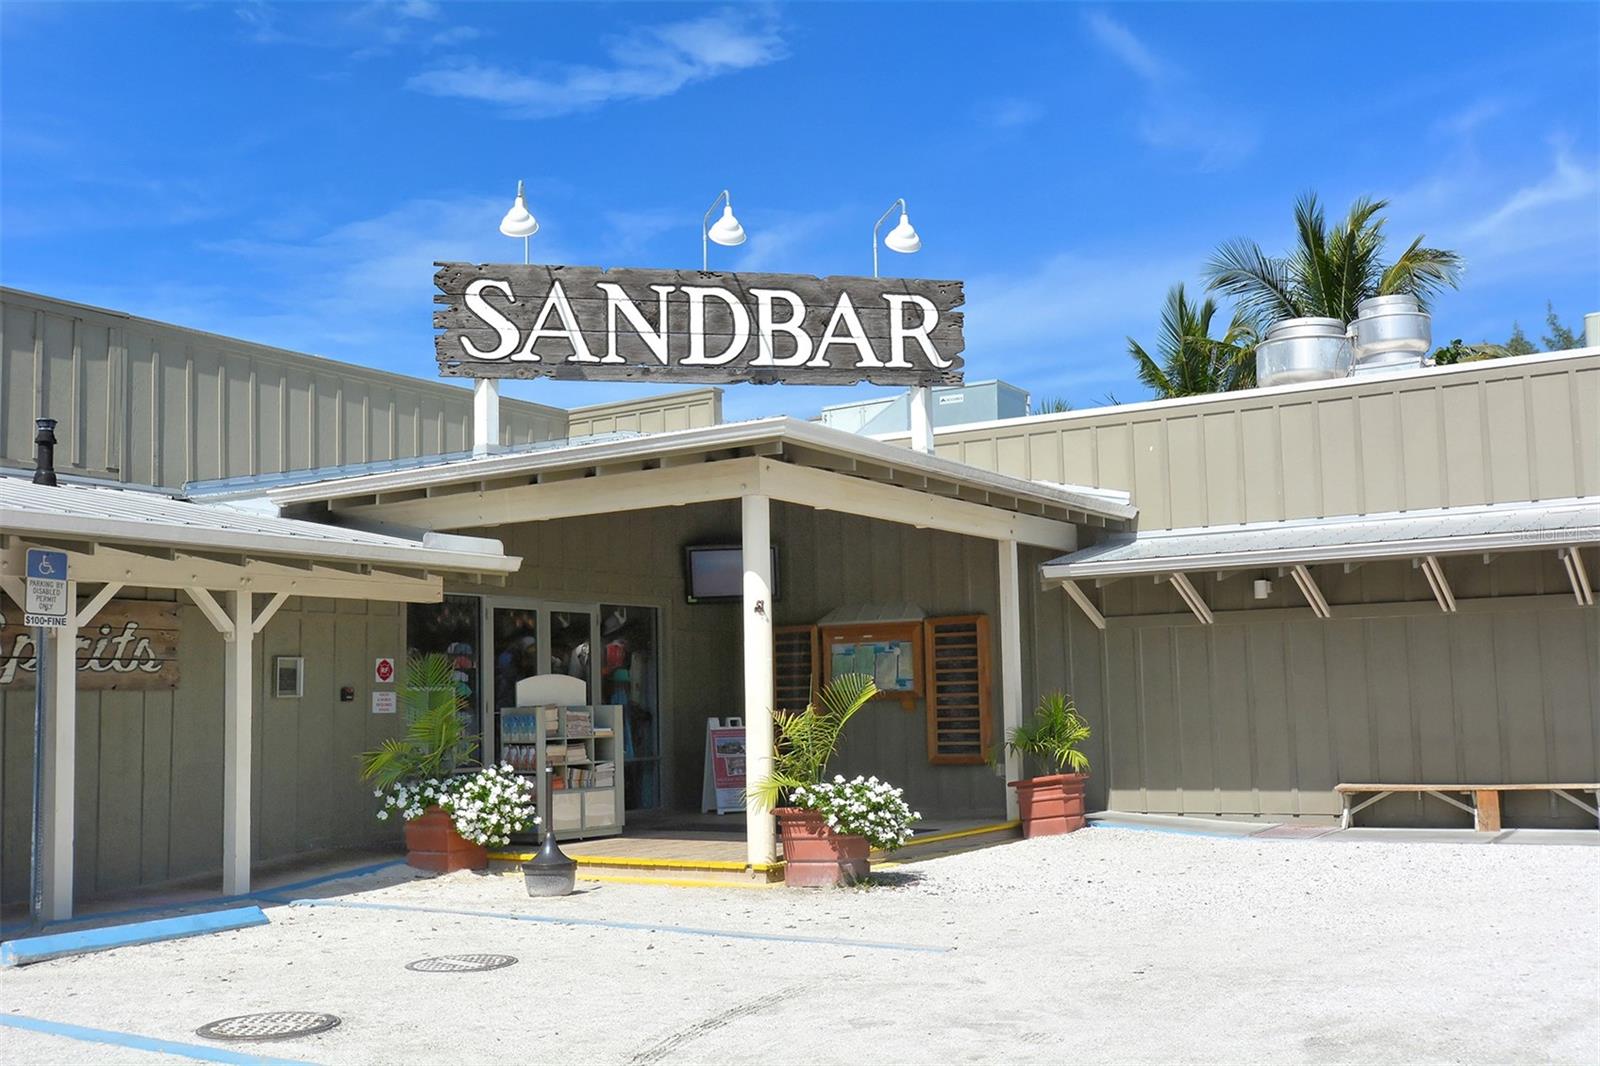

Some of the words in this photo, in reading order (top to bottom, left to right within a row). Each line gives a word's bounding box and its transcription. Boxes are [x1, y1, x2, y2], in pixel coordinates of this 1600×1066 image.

[460, 278, 954, 368] SANDBAR
[29, 580, 54, 588] PARKING
[56, 581, 65, 589] BY
[33, 587, 61, 596] DISABLED
[35, 594, 57, 603] PERMIT
[39, 602, 53, 610] ONLY
[0, 612, 162, 684] prits
